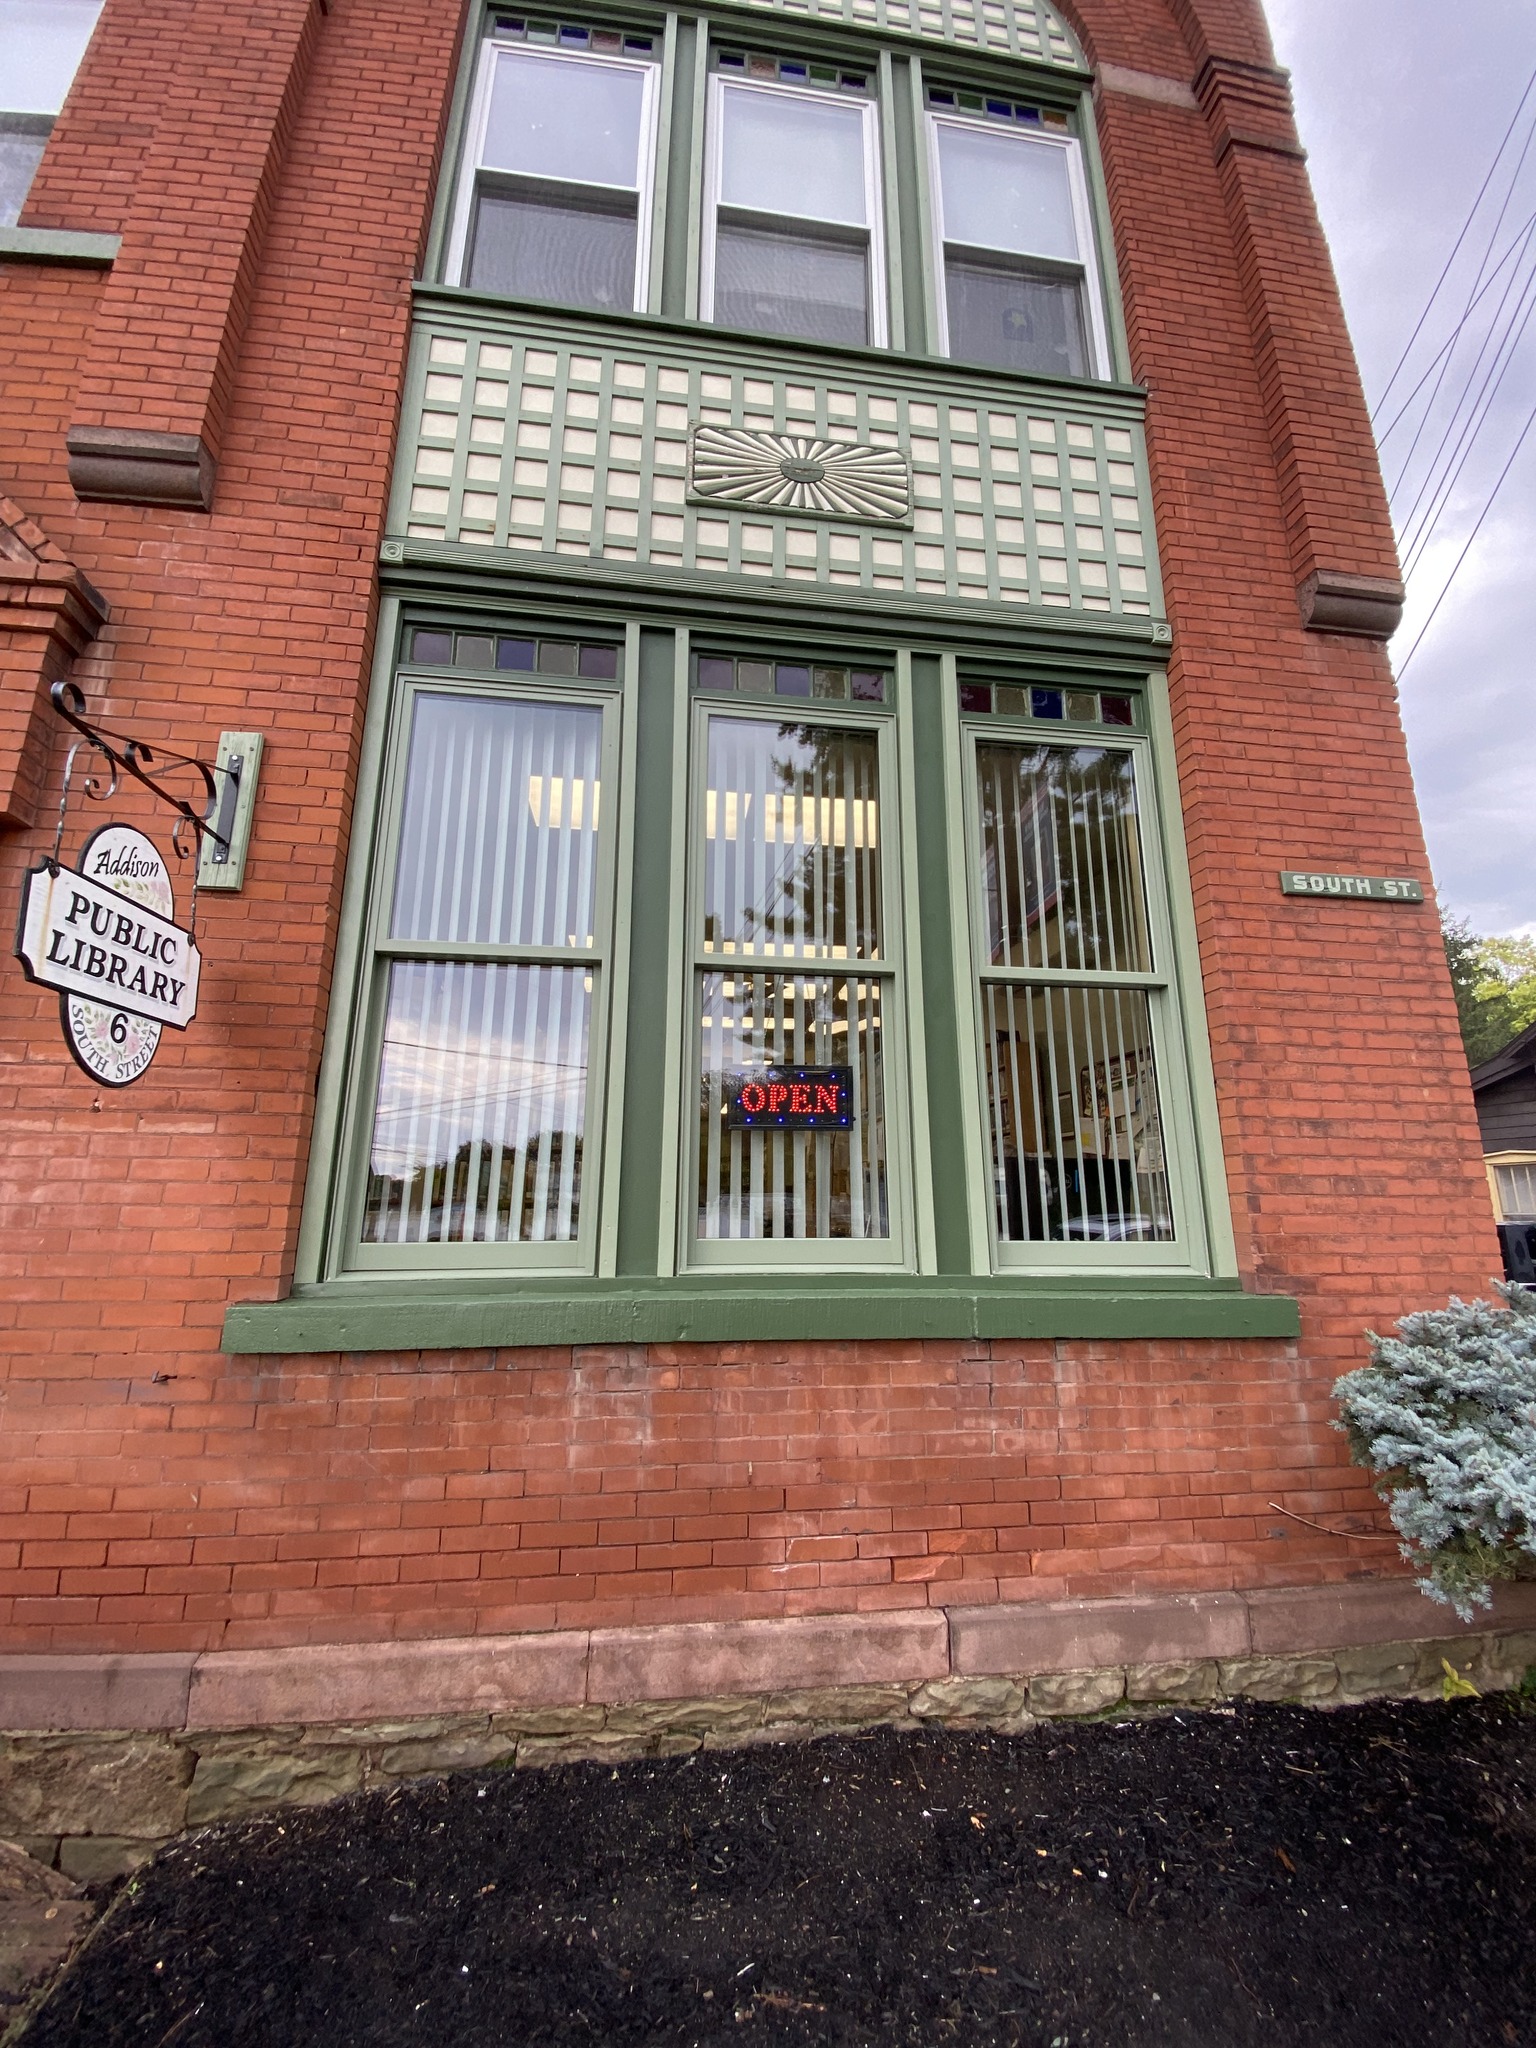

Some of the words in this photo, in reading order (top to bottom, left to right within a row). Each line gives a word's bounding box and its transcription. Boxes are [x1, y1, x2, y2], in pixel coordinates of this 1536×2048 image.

[93, 846, 159, 877] Addison
[1292, 875, 1371, 895] SOUTH
[1383, 880, 1417, 897] ST.
[65, 891, 177, 965] PUBLIC
[46, 929, 186, 1006] LIBRARY
[72, 1004, 110, 1073] SOUTH
[115, 1026, 158, 1079] STREET
[110, 1013, 129, 1044] 6
[741, 1083, 840, 1113] OPEN
